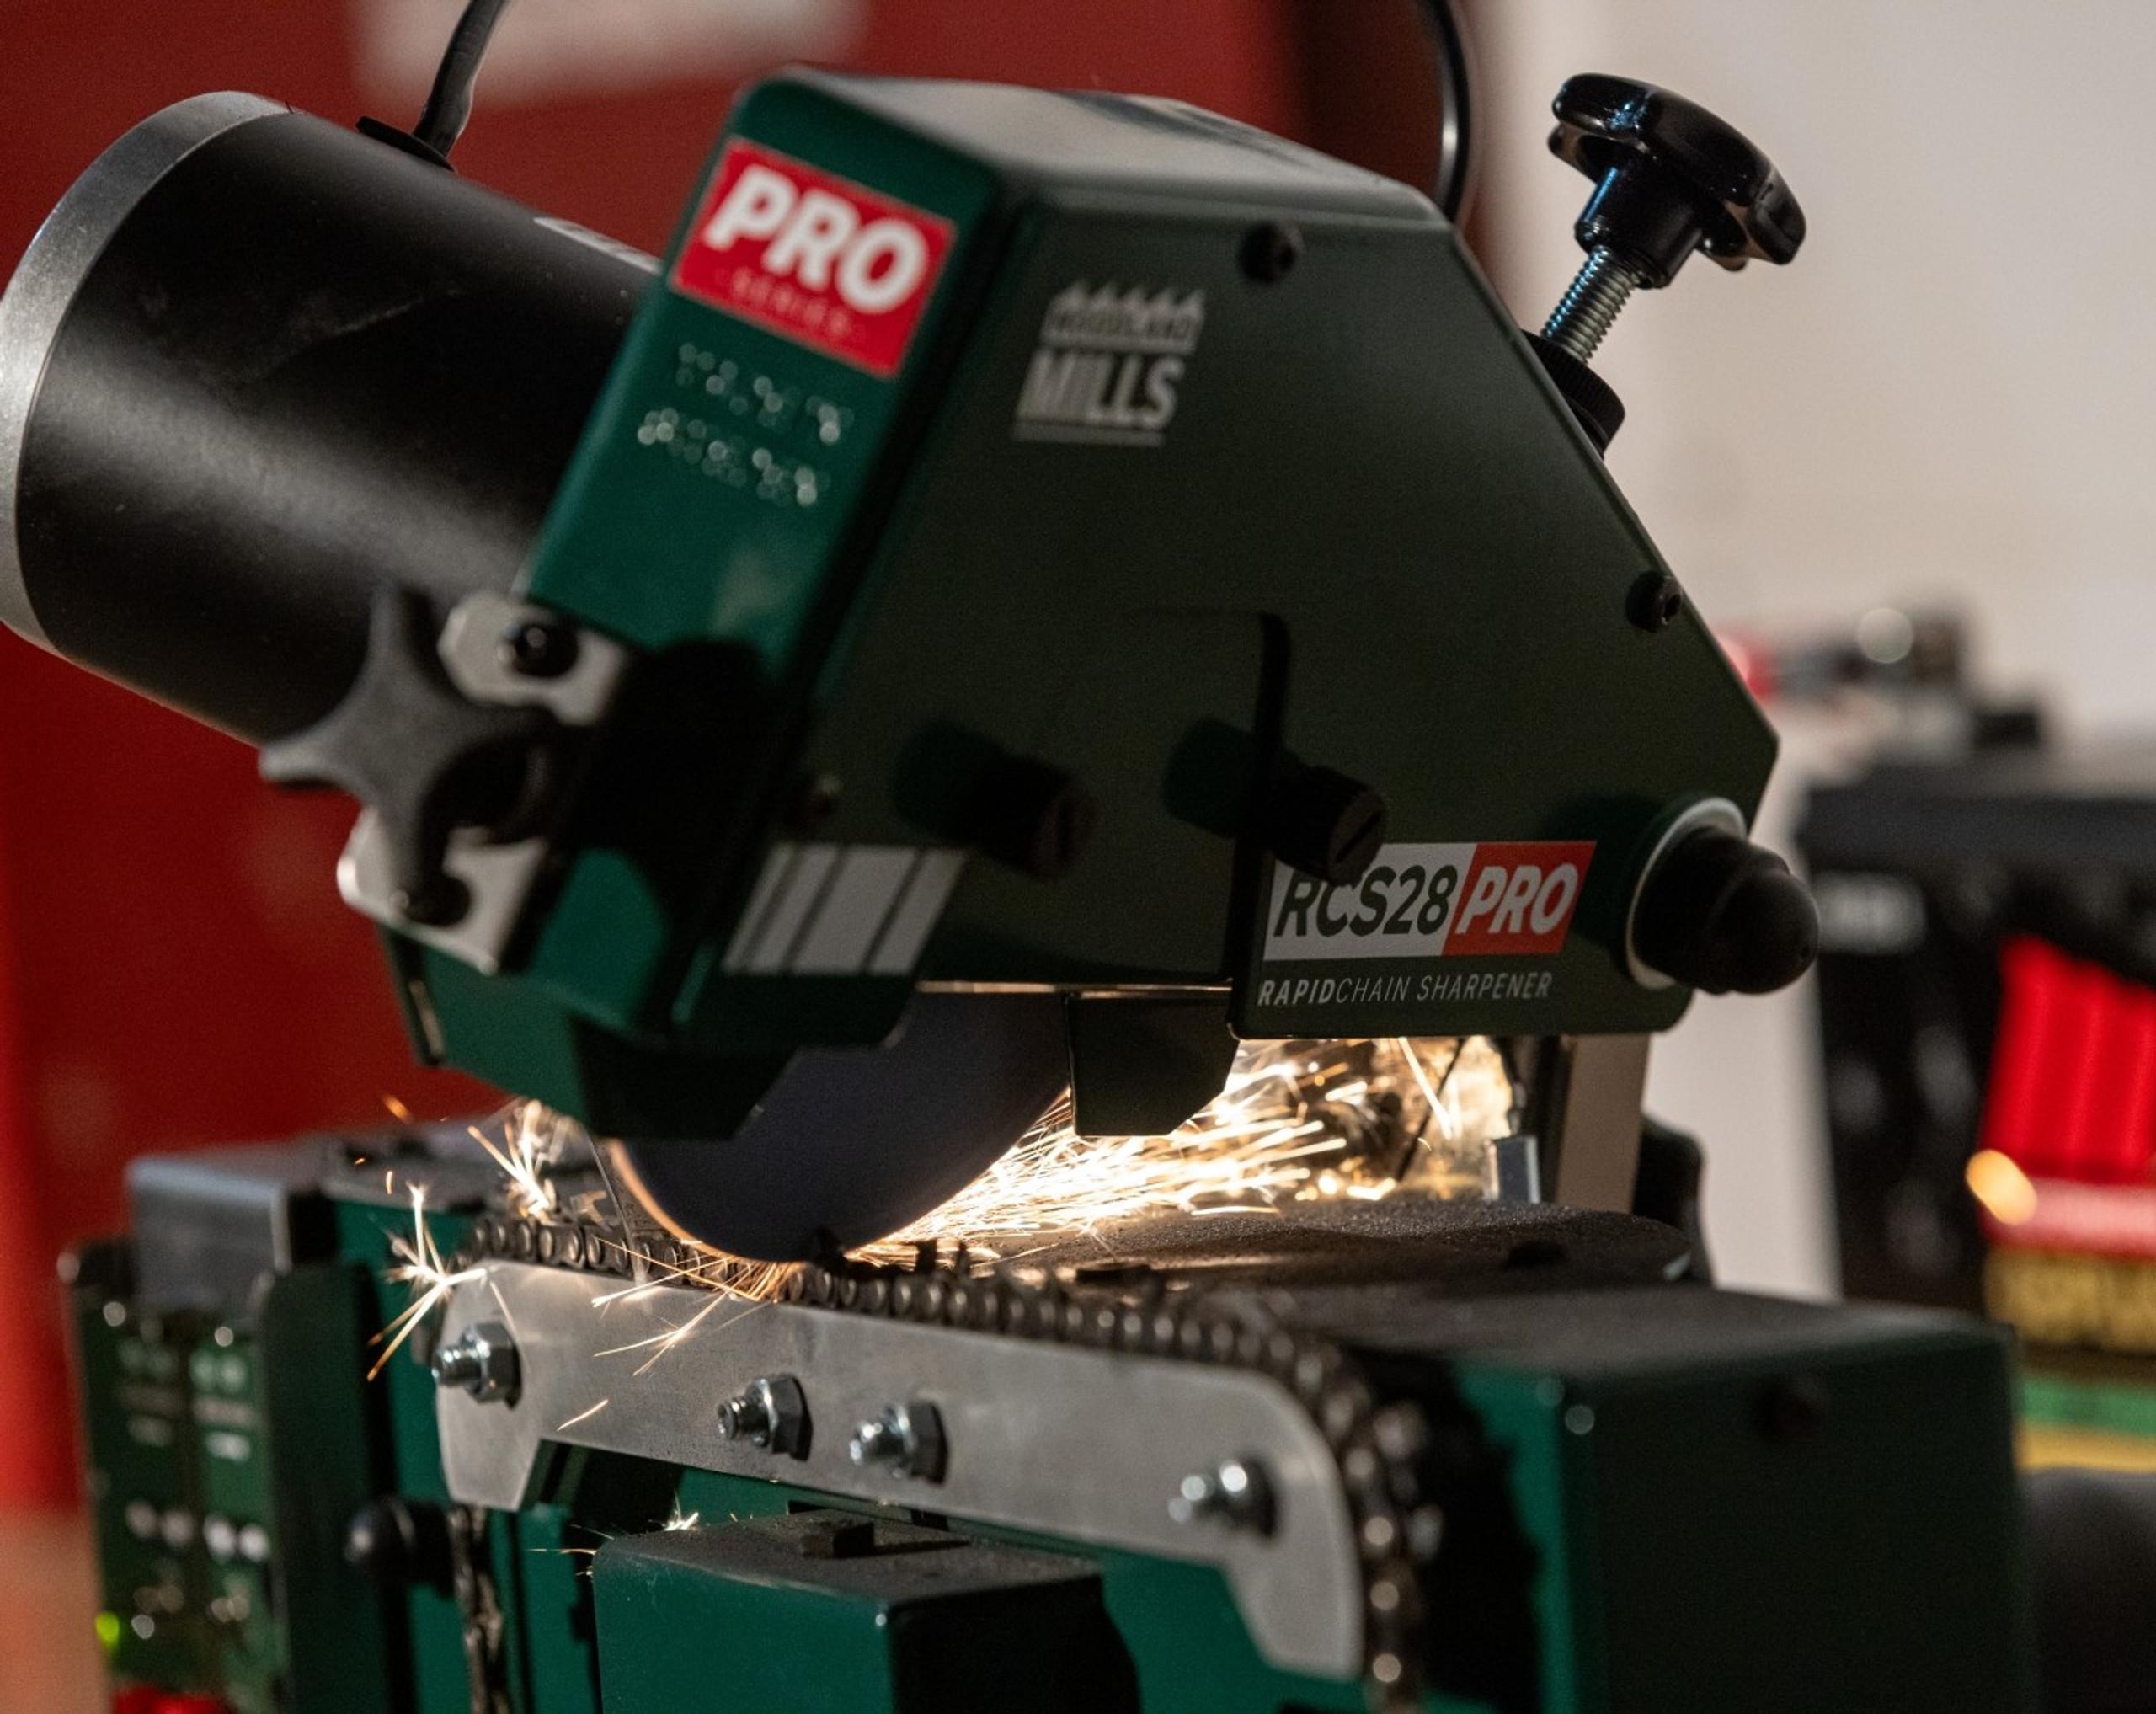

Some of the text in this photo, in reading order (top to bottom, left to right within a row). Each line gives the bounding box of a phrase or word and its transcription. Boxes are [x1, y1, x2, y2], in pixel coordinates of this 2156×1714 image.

[702, 163, 929, 315] PRO
[1273, 863, 1579, 937] RCS28 PRO
[1417, 972, 1553, 1002] SHARPENER
